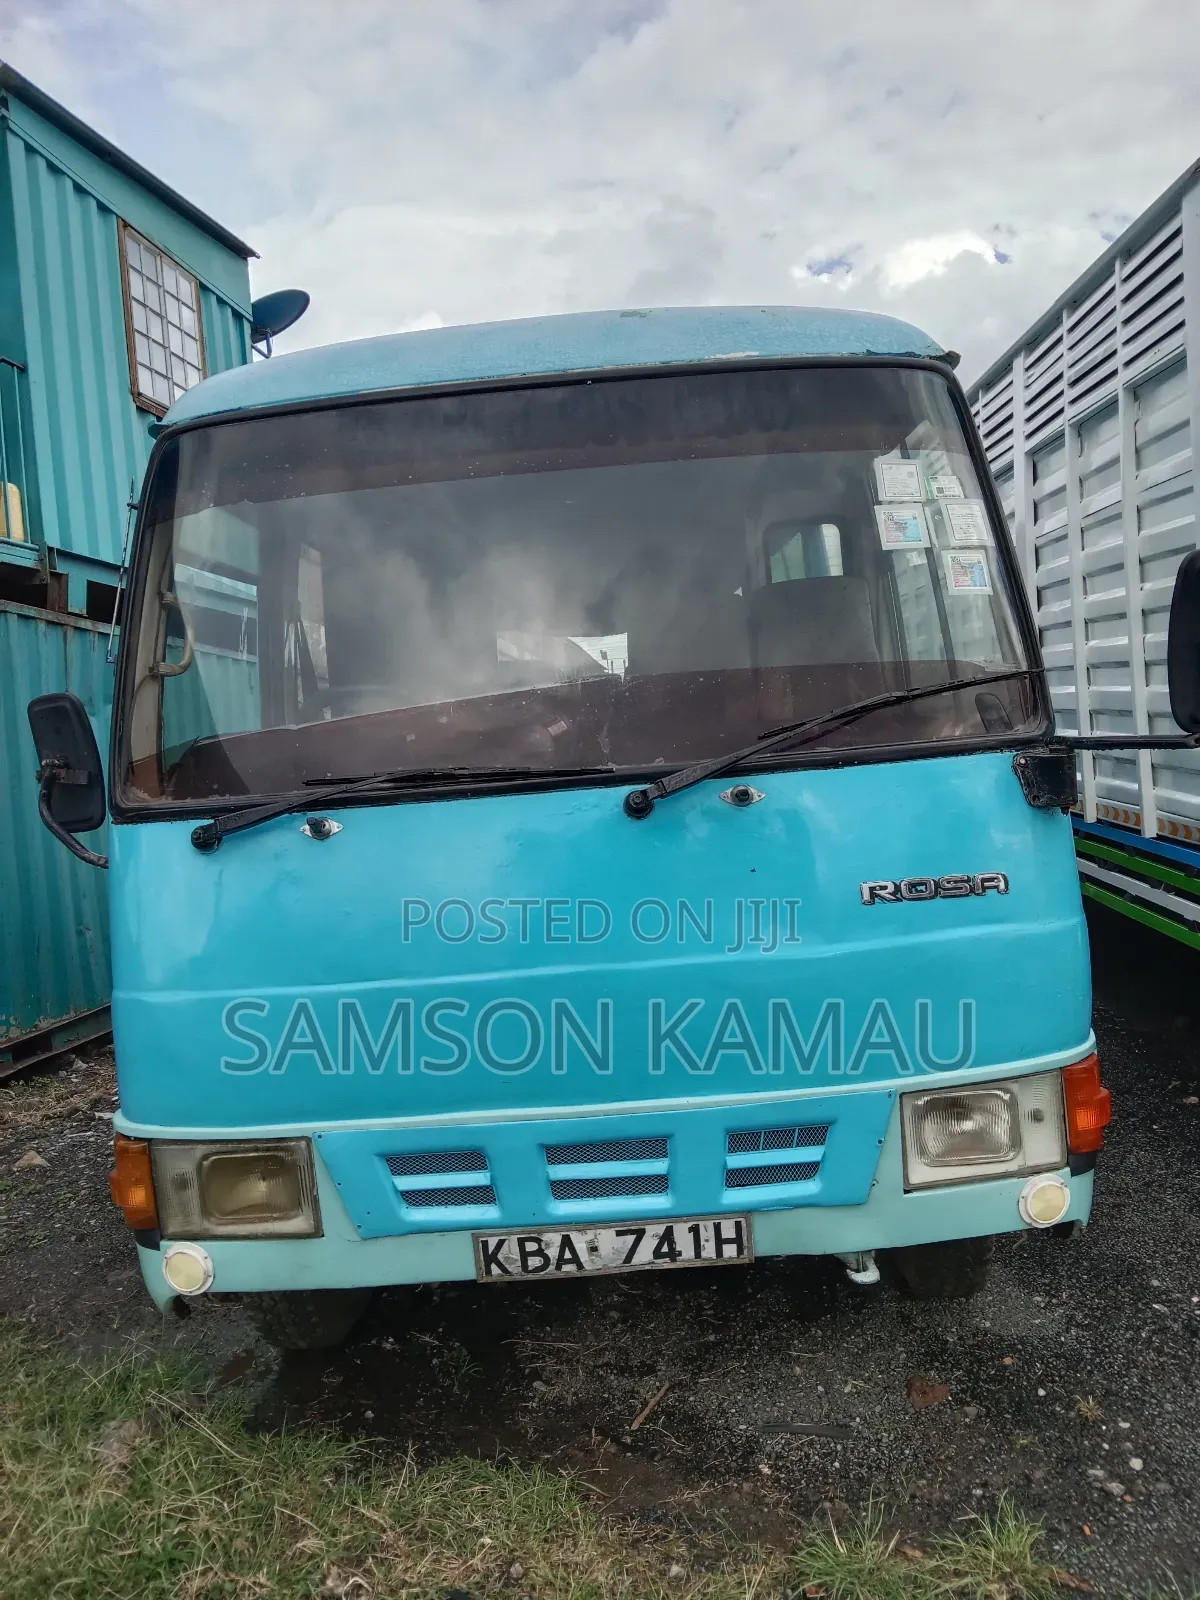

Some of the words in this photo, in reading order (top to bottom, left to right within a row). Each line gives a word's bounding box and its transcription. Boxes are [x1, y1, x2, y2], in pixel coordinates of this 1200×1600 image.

[860, 872, 1009, 905] ROSA
[480, 1234, 585, 1276] KBA
[615, 1220, 745, 1264] 741H
